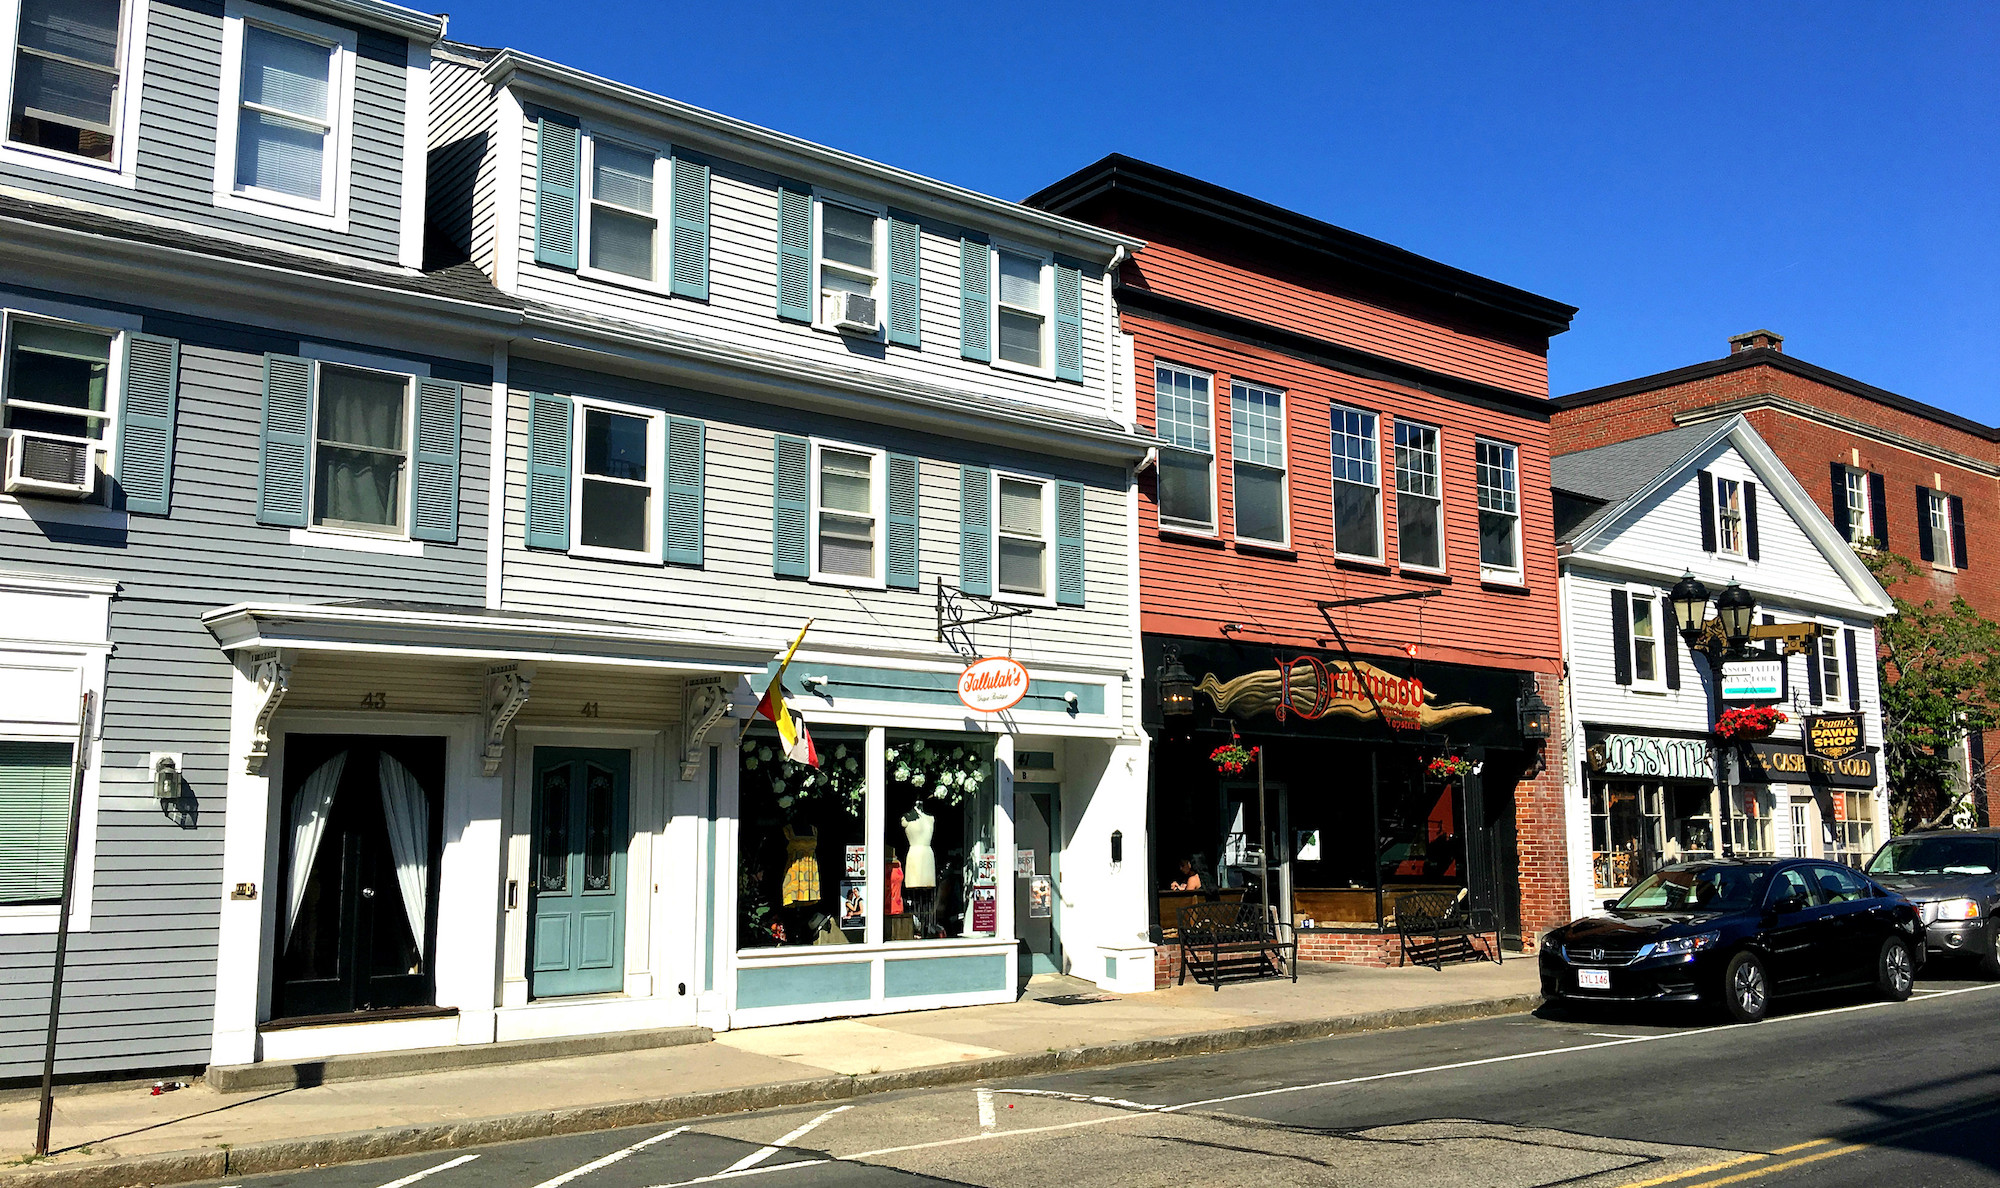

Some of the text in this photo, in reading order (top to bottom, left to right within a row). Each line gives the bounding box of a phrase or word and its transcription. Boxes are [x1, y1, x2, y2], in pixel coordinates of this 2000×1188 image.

[1723, 665, 1780, 673] ASSOCIATED
[964, 668, 1021, 692] Tallulah's
[1275, 656, 1424, 721] Driftwood
[361, 692, 386, 710] 43
[581, 702, 599, 718] 41
[1811, 727, 1859, 739] PAWN
[1813, 736, 1857, 748] SHOP
[1604, 734, 1706, 778] LOCKSMITH
[1772, 752, 1807, 773] CASH
[1838, 757, 1872, 777] GOLD
[1022, 771, 1027, 780] B
[846, 853, 866, 862] BEST
[1018, 856, 1033, 865] BEST
[979, 860, 996, 869] BEST
[1595, 975, 1608, 984] 146
